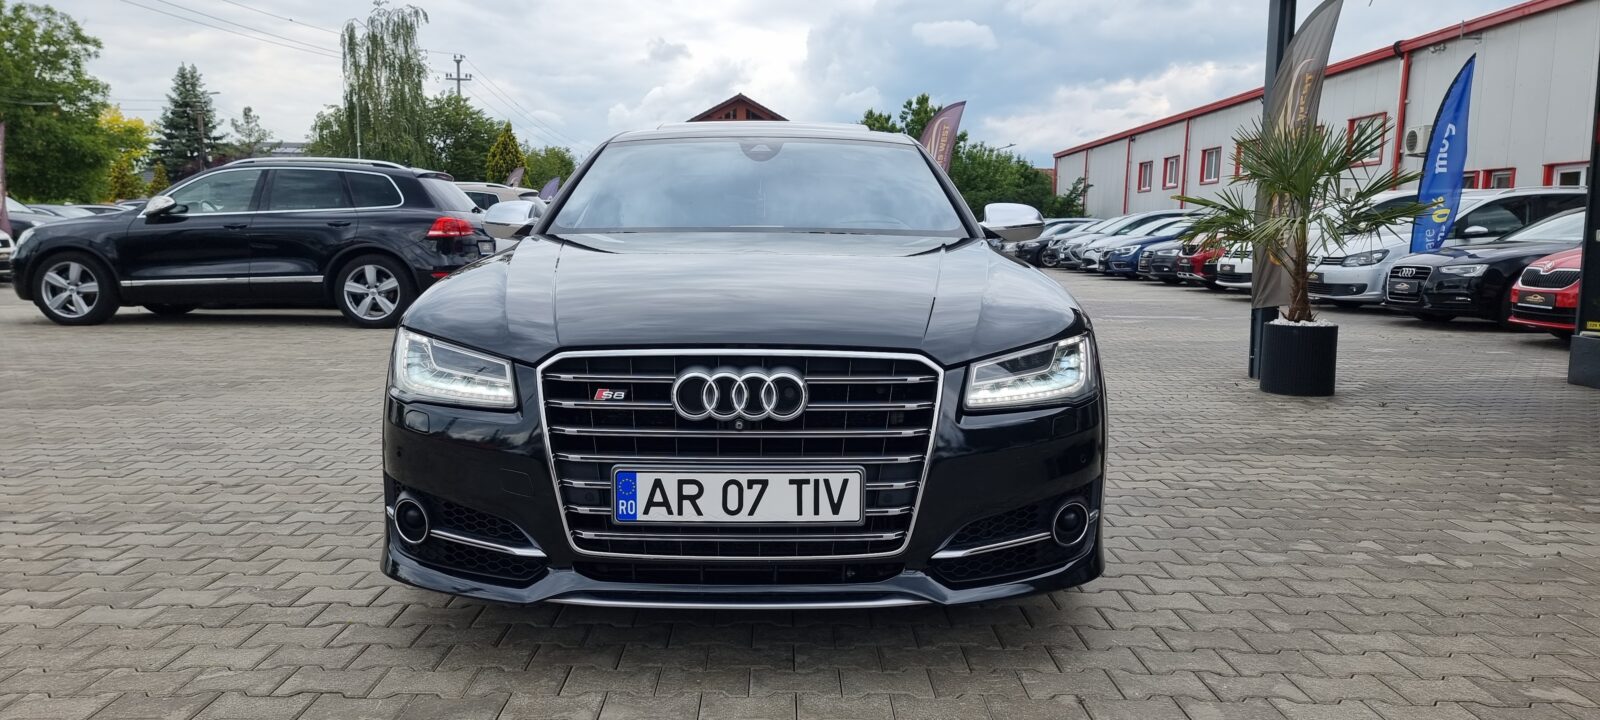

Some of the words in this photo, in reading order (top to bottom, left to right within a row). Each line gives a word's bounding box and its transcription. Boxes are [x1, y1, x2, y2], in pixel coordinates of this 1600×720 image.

[939, 124, 949, 152] WEST
[601, 391, 625, 400] S8
[619, 500, 636, 515] RO
[642, 478, 704, 516] AR
[721, 478, 769, 517] 07
[788, 478, 849, 516] TIV
